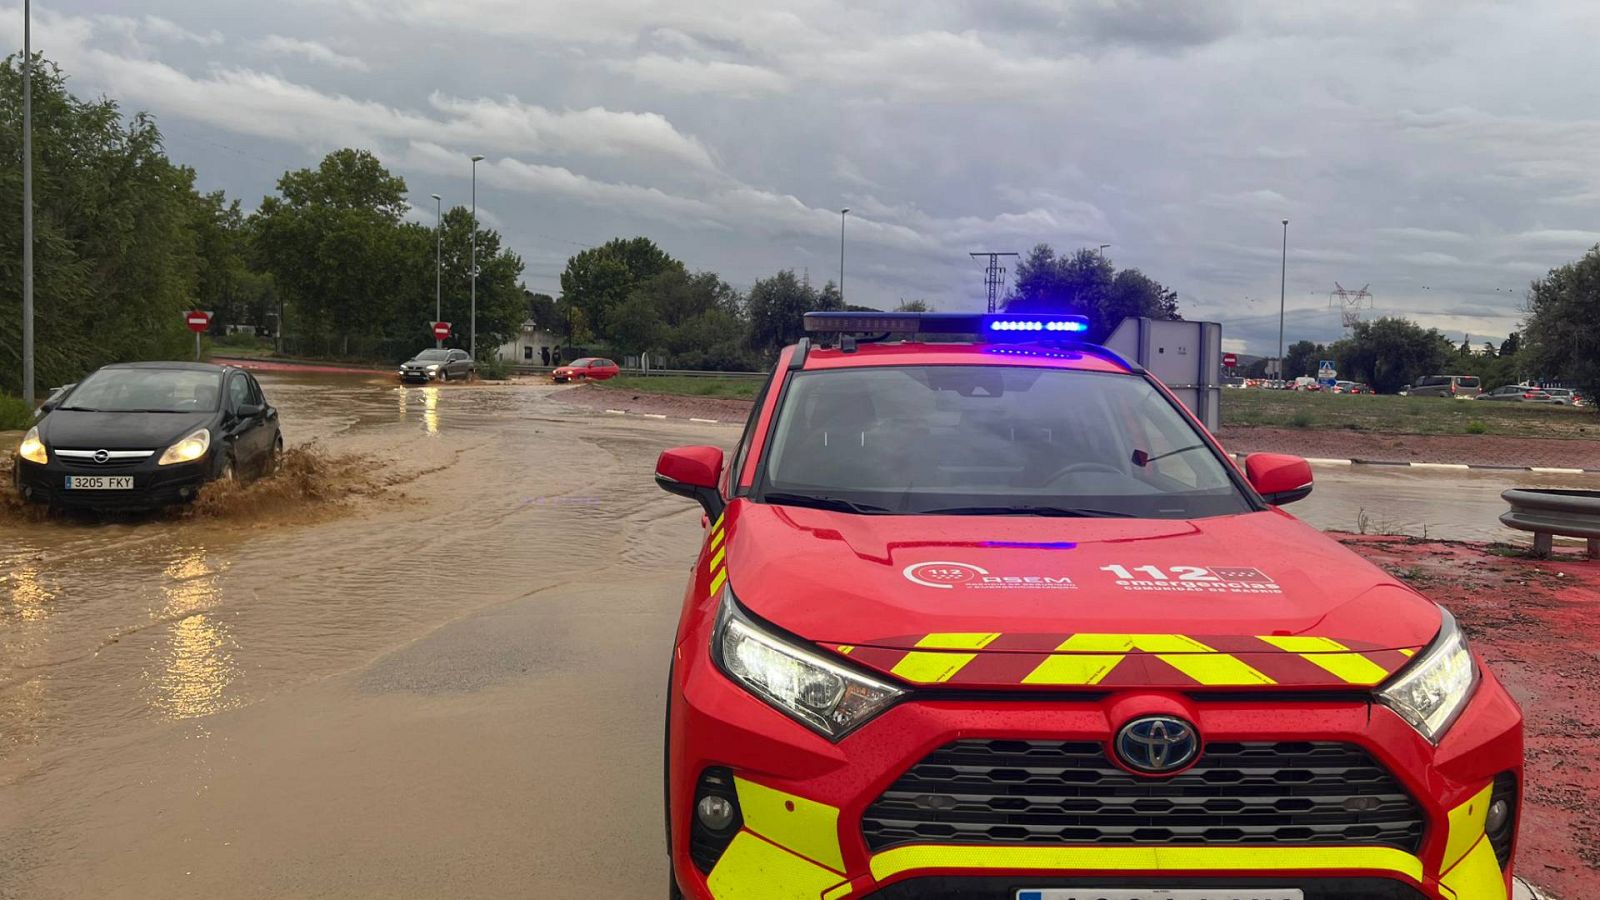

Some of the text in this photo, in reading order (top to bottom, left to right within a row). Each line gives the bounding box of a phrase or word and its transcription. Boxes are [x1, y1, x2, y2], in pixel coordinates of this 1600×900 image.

[75, 478, 131, 487] 3205 FKY
[1100, 564, 1219, 581] 112
[1115, 580, 1280, 589] emergencias
